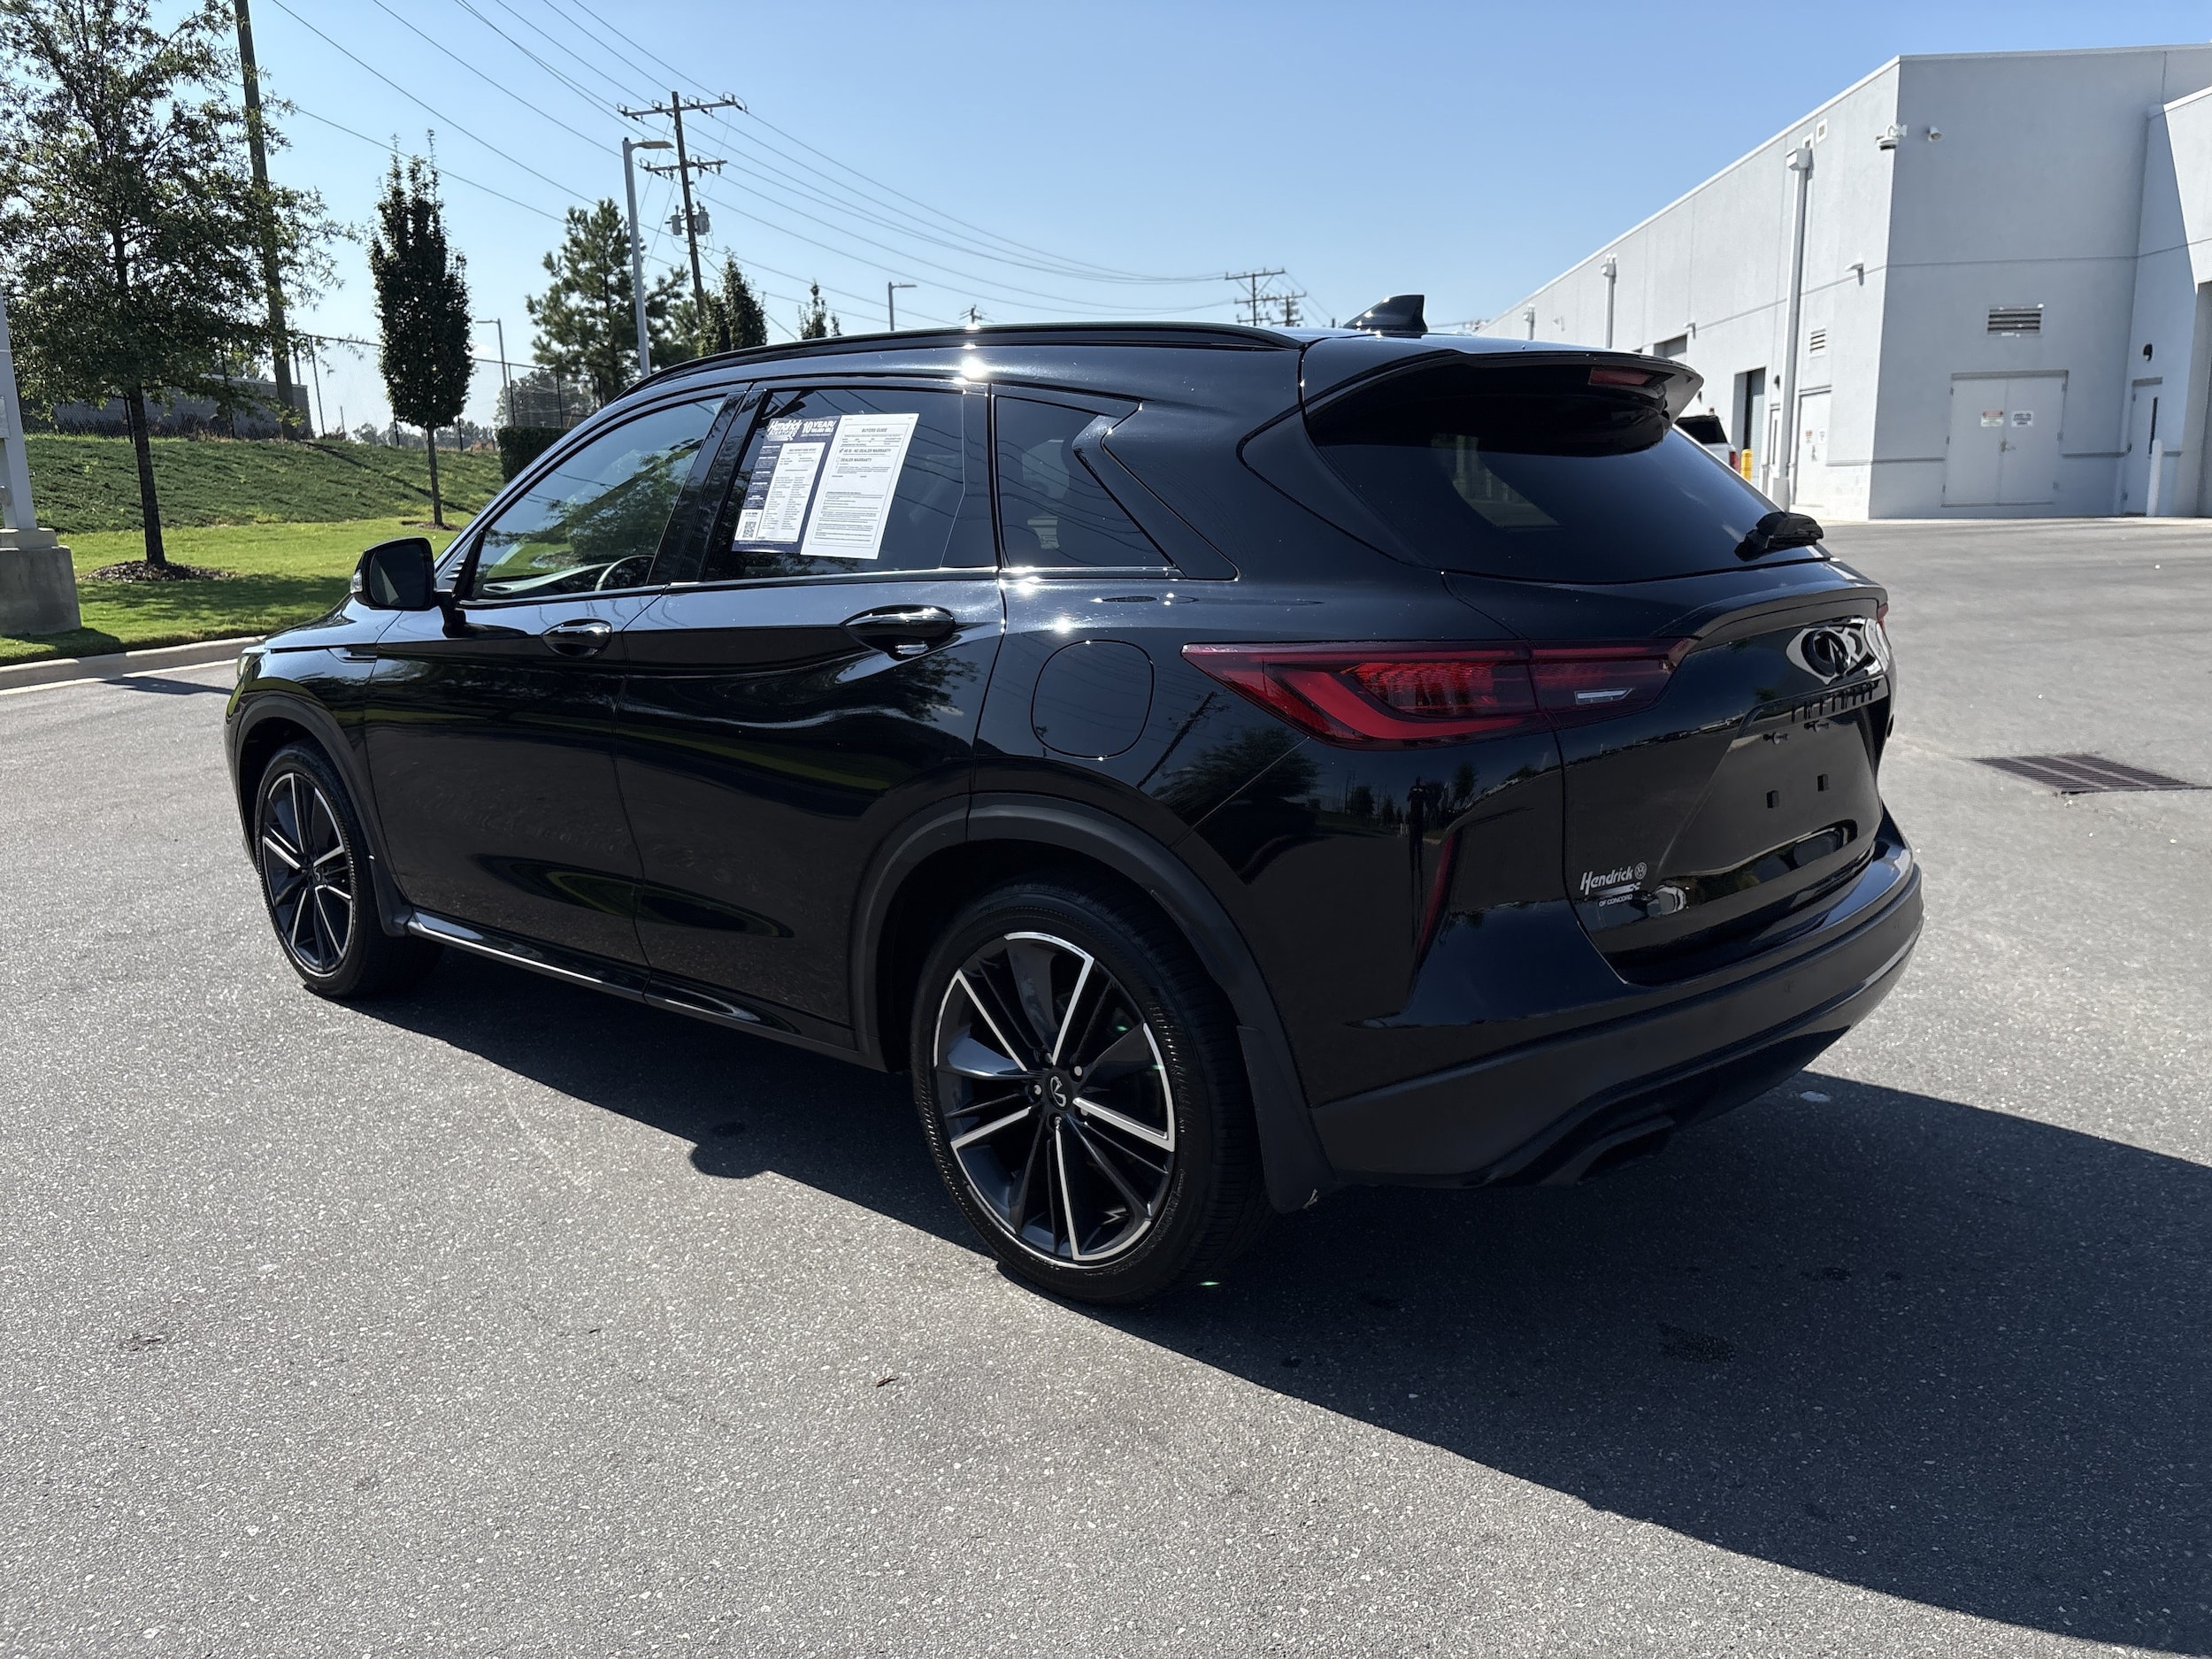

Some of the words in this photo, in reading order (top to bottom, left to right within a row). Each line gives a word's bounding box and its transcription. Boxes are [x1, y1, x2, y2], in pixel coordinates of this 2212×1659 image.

[802, 421, 813, 434] 10
[1580, 866, 1633, 895] Hendrick
[1607, 894, 1633, 905] CONCORD
